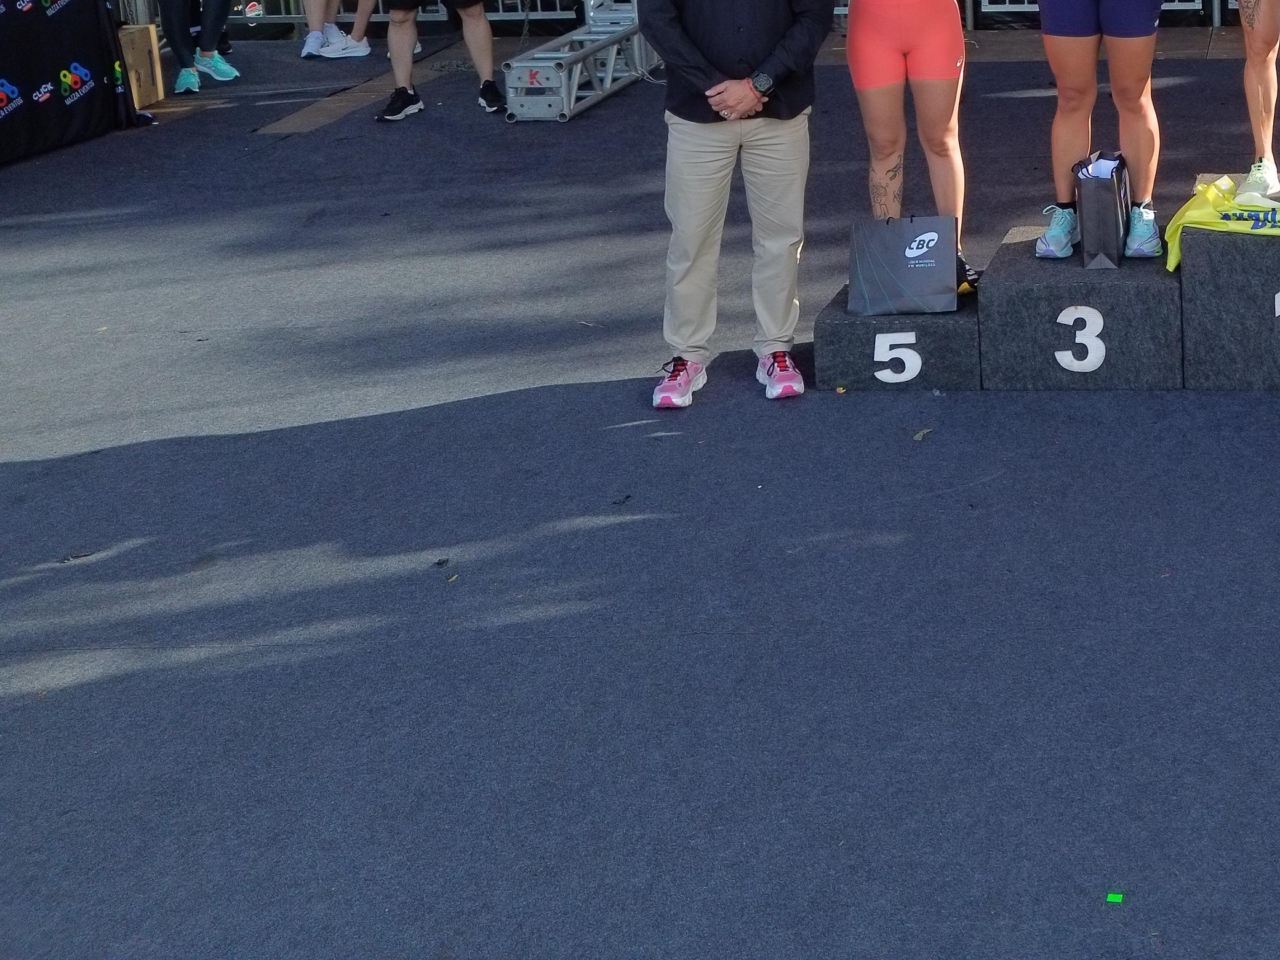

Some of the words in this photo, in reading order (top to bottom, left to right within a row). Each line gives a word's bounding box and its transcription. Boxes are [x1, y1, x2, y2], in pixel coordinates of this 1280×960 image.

[33, 82, 54, 101] CLICK
[529, 68, 543, 87] K
[1054, 305, 1107, 373] 3
[873, 331, 923, 384] 5
